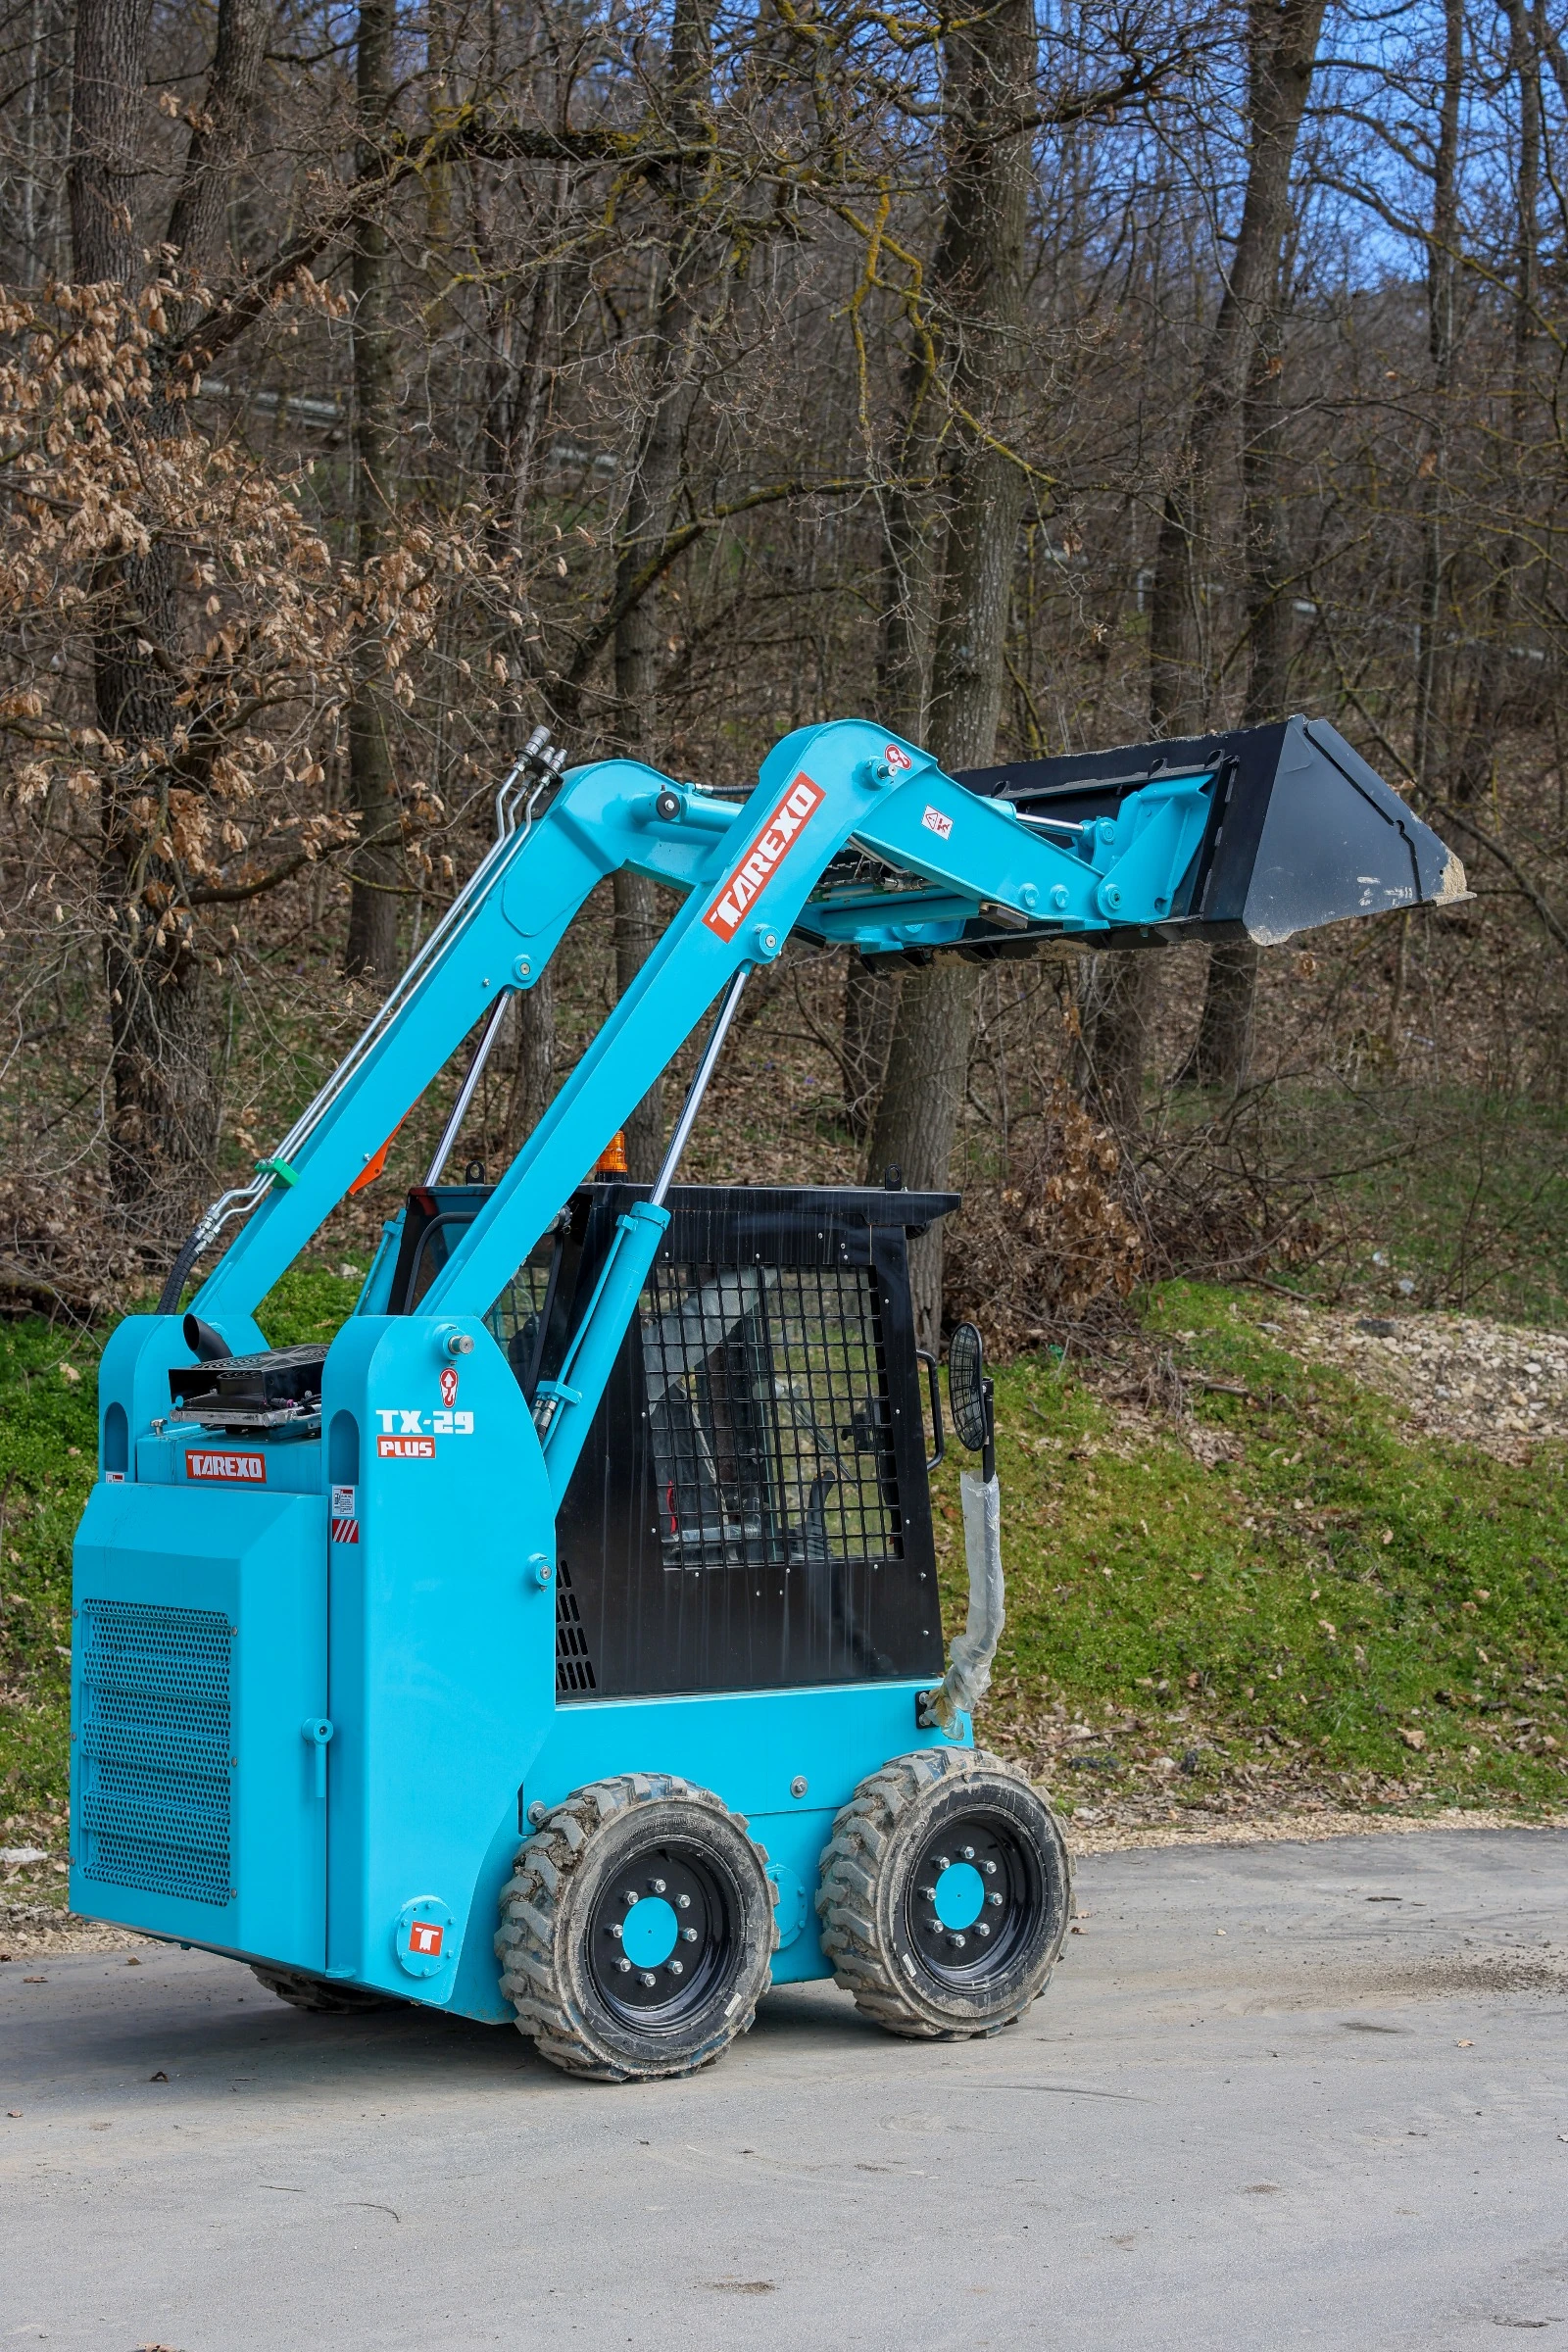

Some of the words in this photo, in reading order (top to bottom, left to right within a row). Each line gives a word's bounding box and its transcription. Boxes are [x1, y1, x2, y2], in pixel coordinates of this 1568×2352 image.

[710, 783, 817, 928] TAREXO
[375, 1409, 474, 1435] TX-29
[380, 1441, 432, 1457] PLUS
[188, 1454, 263, 1479] TAREXO
